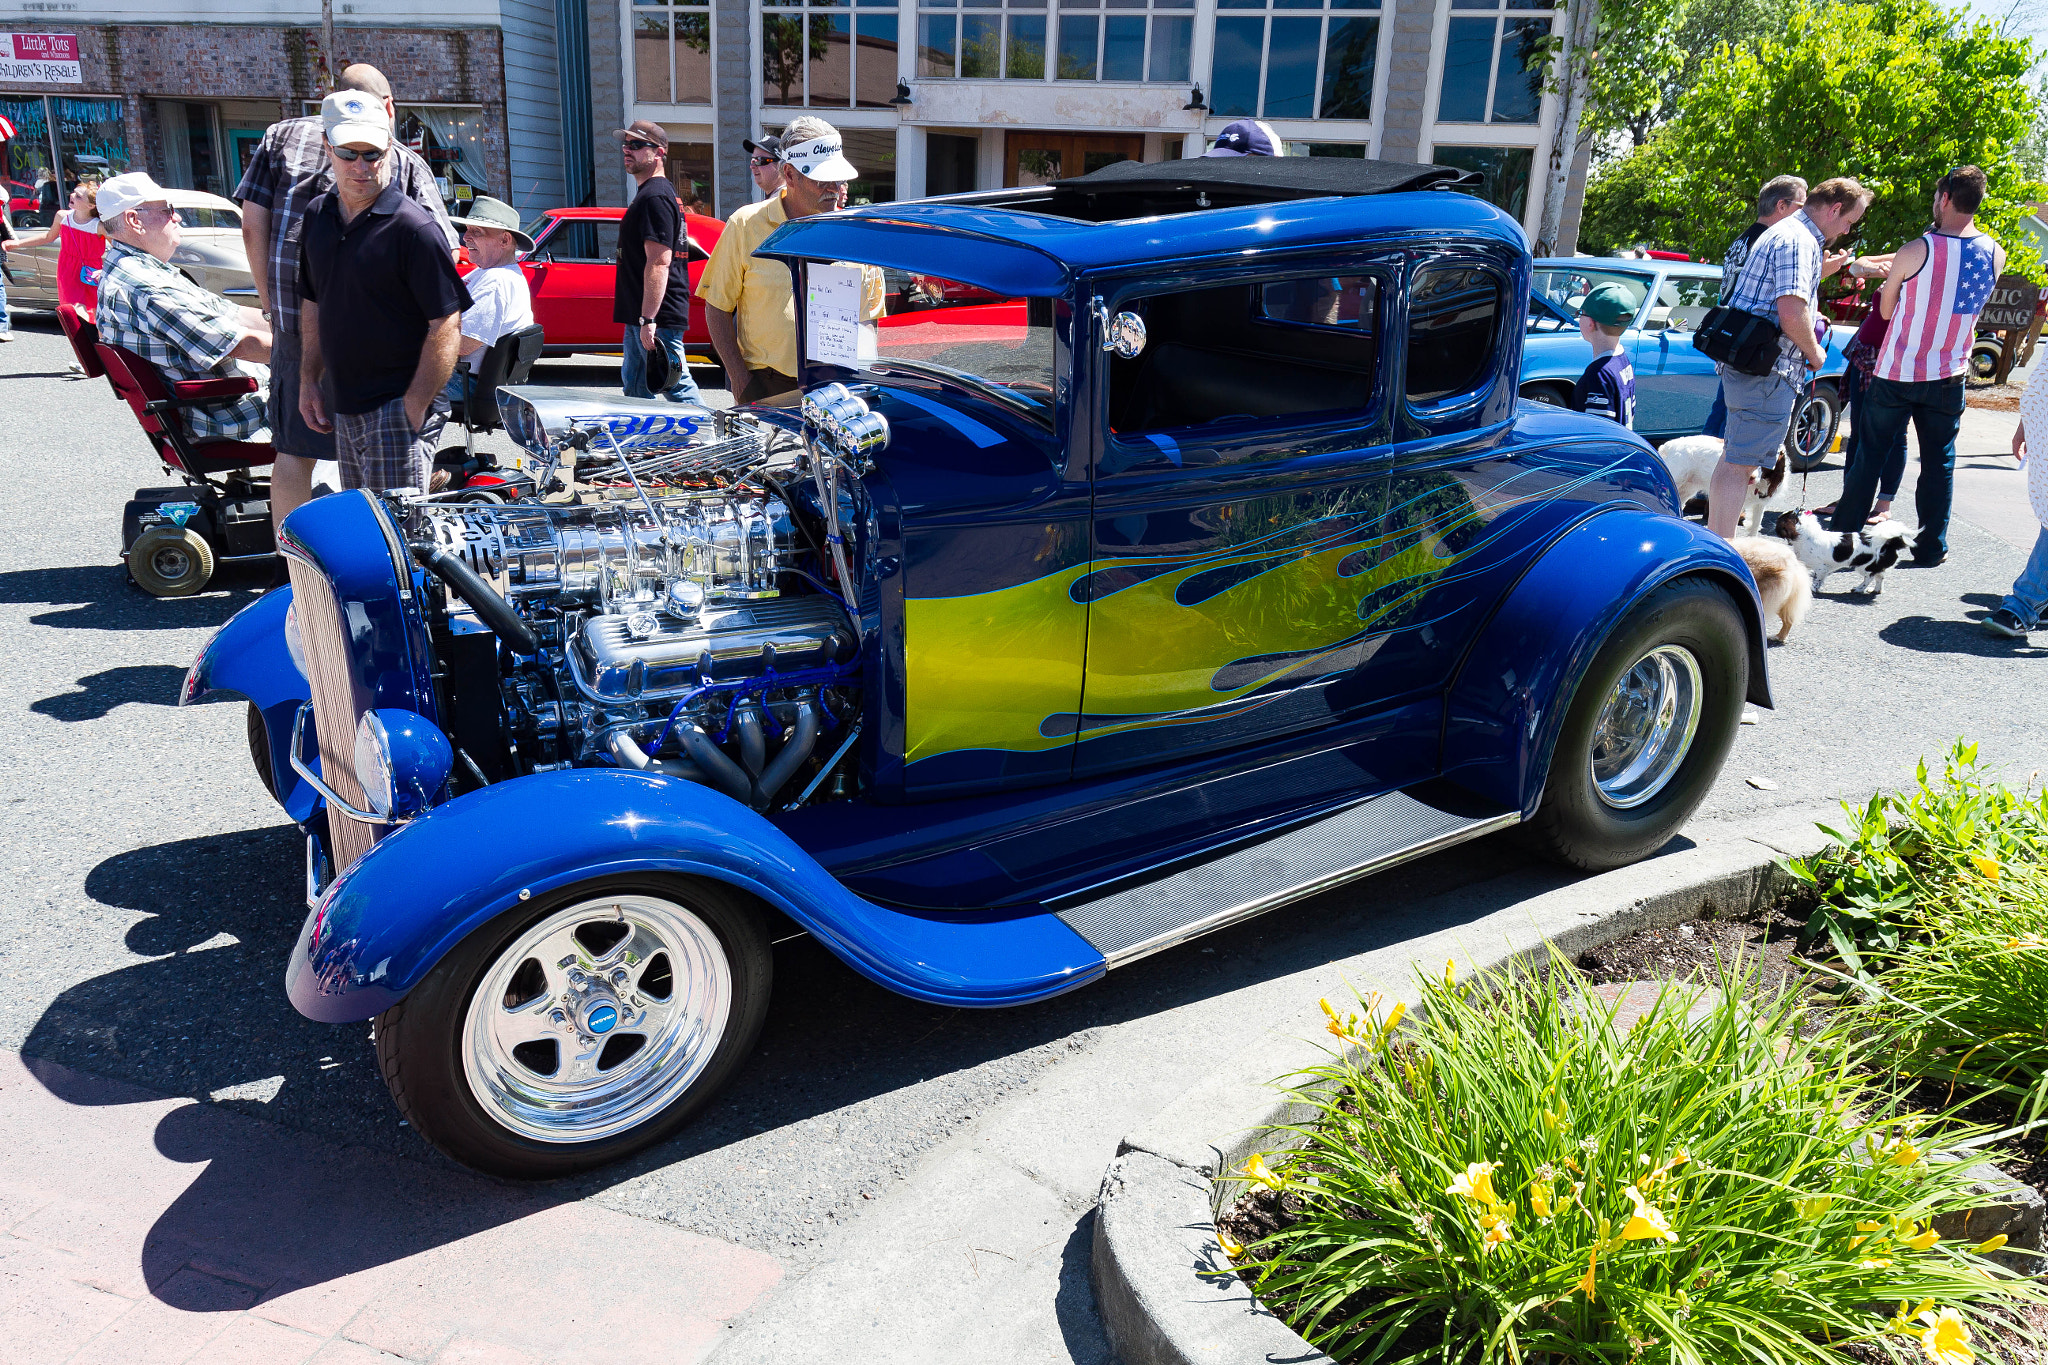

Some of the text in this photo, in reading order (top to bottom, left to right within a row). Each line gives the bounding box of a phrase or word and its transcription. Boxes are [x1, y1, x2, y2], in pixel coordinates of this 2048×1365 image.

[21, 36, 70, 51] Little Tots
[13, 145, 45, 170] SALE
[1987, 288, 2022, 306] LIC
[597, 414, 704, 436] BDS
[590, 1013, 615, 1026] CRAGAR
